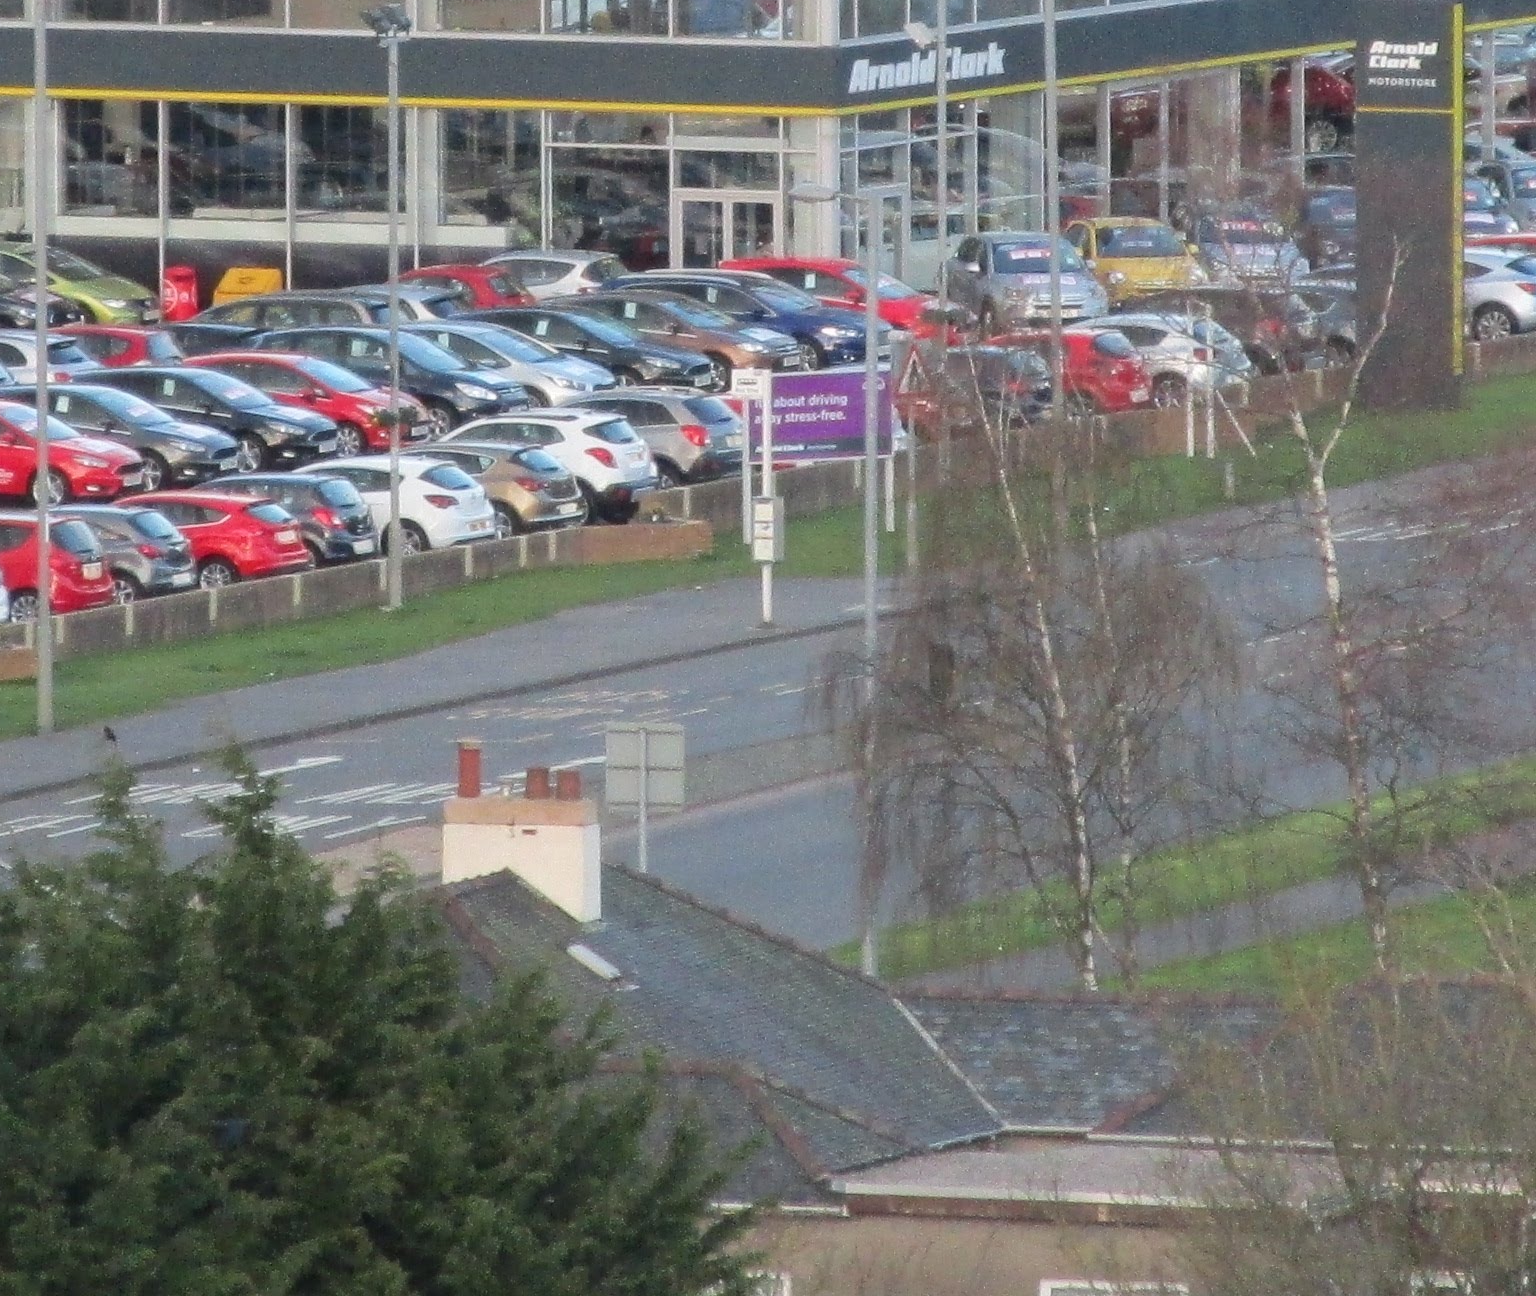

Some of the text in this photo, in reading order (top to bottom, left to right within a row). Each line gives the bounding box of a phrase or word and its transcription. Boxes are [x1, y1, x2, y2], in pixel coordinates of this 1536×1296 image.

[1369, 40, 1438, 55] Arnold
[1369, 55, 1422, 70] Clark
[848, 49, 937, 94] Arnold
[1368, 77, 1437, 87] MOTORSTORE
[773, 395, 805, 408] about
[808, 392, 848, 407] driving
[785, 408, 847, 424] stress-free.
